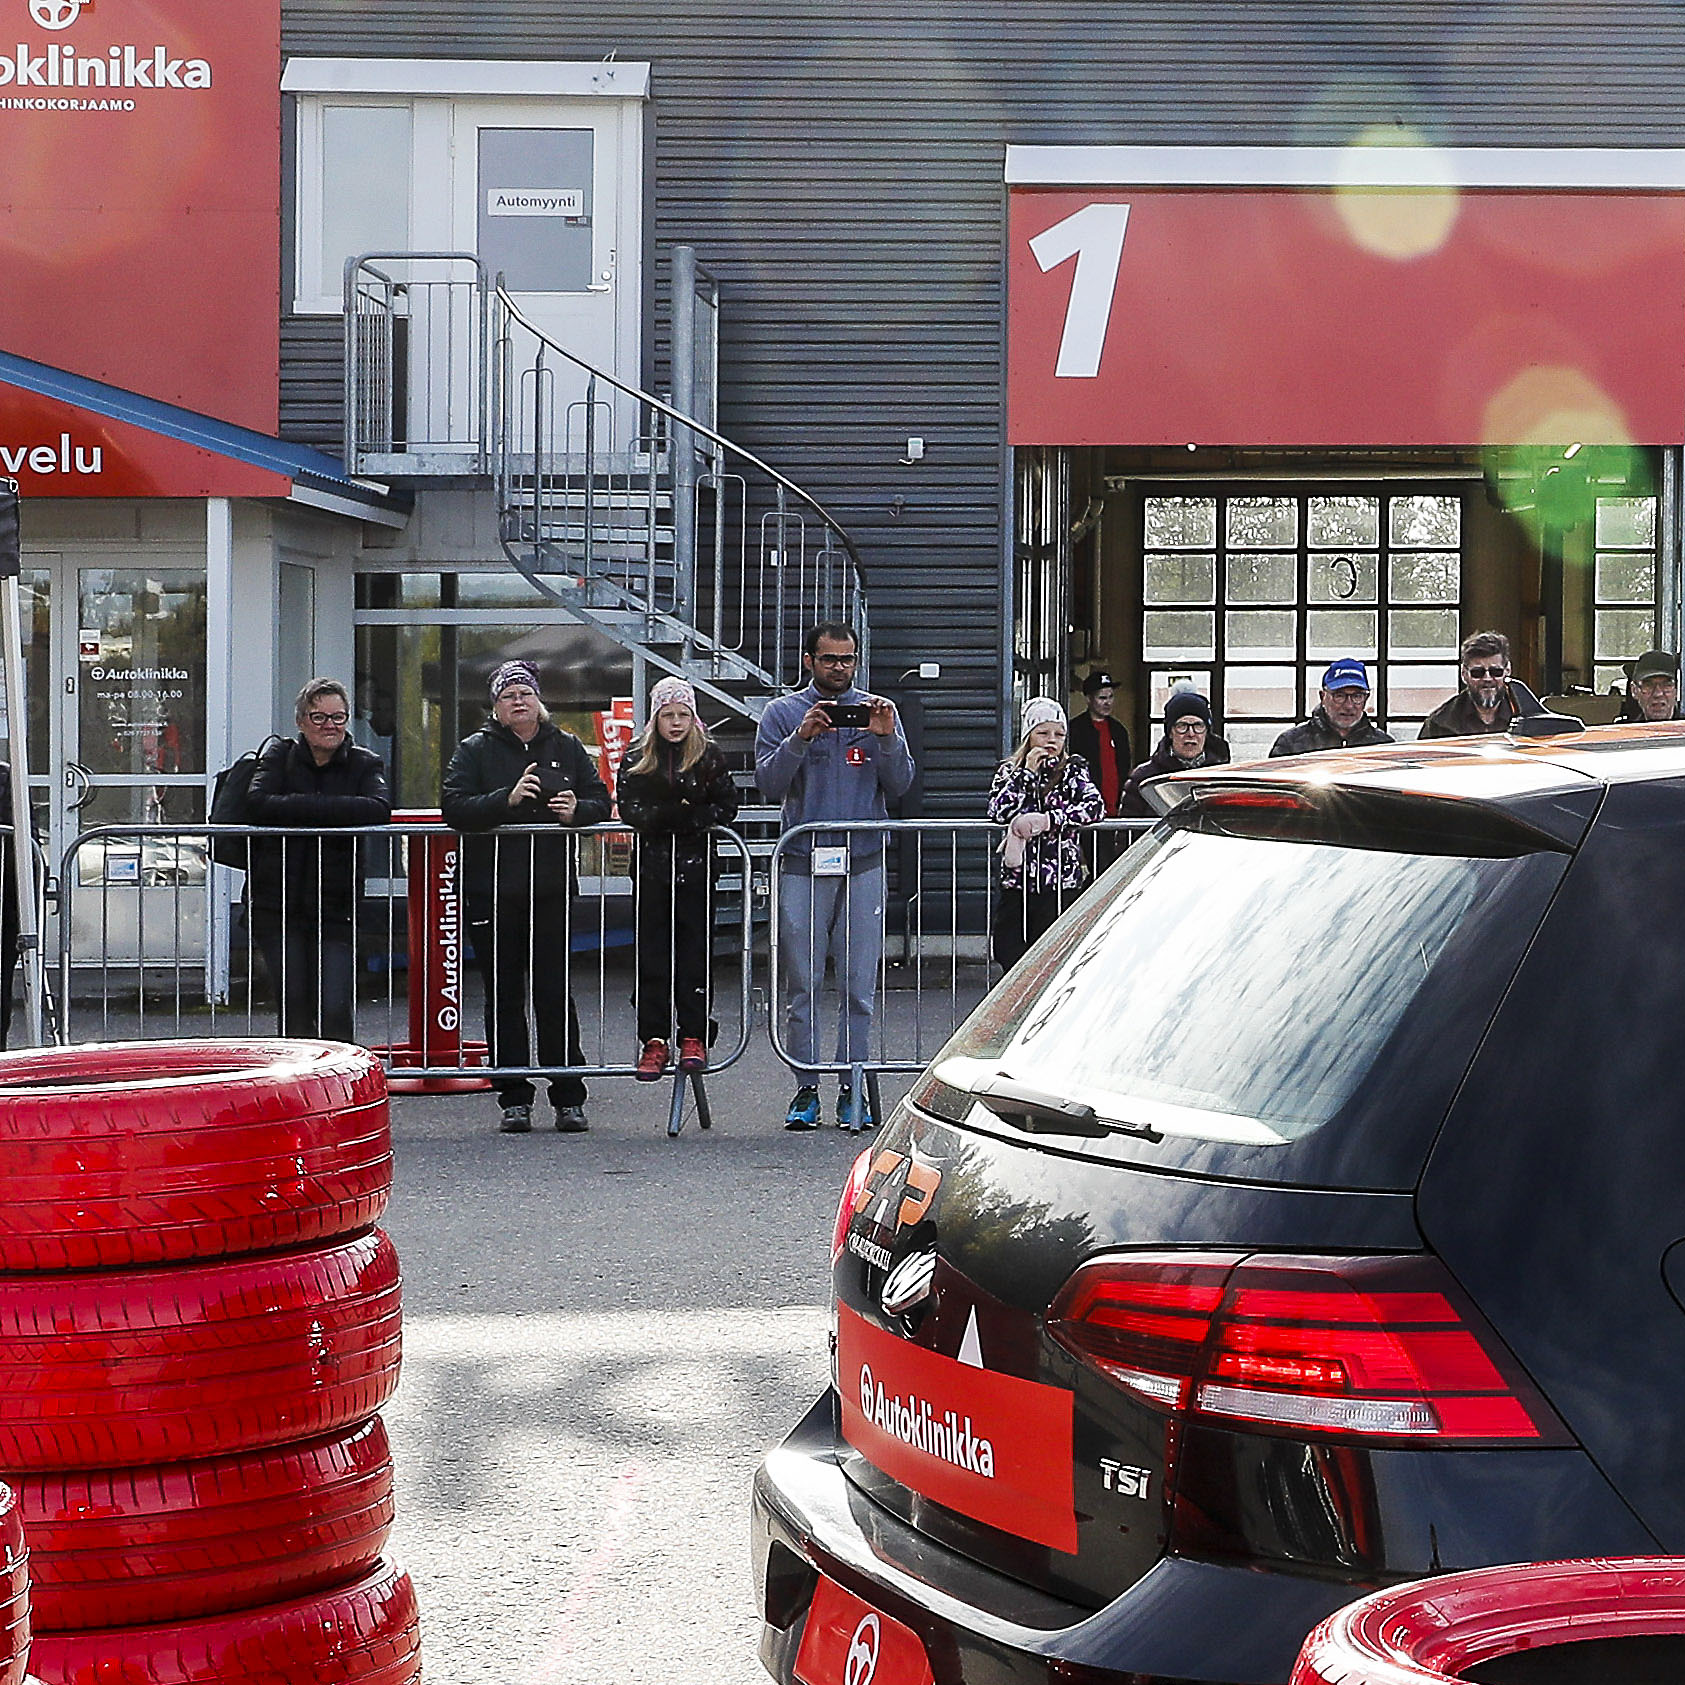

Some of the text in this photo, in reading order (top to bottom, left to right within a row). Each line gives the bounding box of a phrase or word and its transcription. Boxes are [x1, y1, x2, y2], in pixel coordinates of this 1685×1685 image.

[496, 195, 576, 210] Automyynti
[1028, 203, 1131, 378] 1
[0, 433, 102, 473] velu
[105, 667, 189, 680] Autoklinikka
[439, 850, 458, 1005] Autoklinikka
[874, 1381, 995, 1479] Autoklinikka
